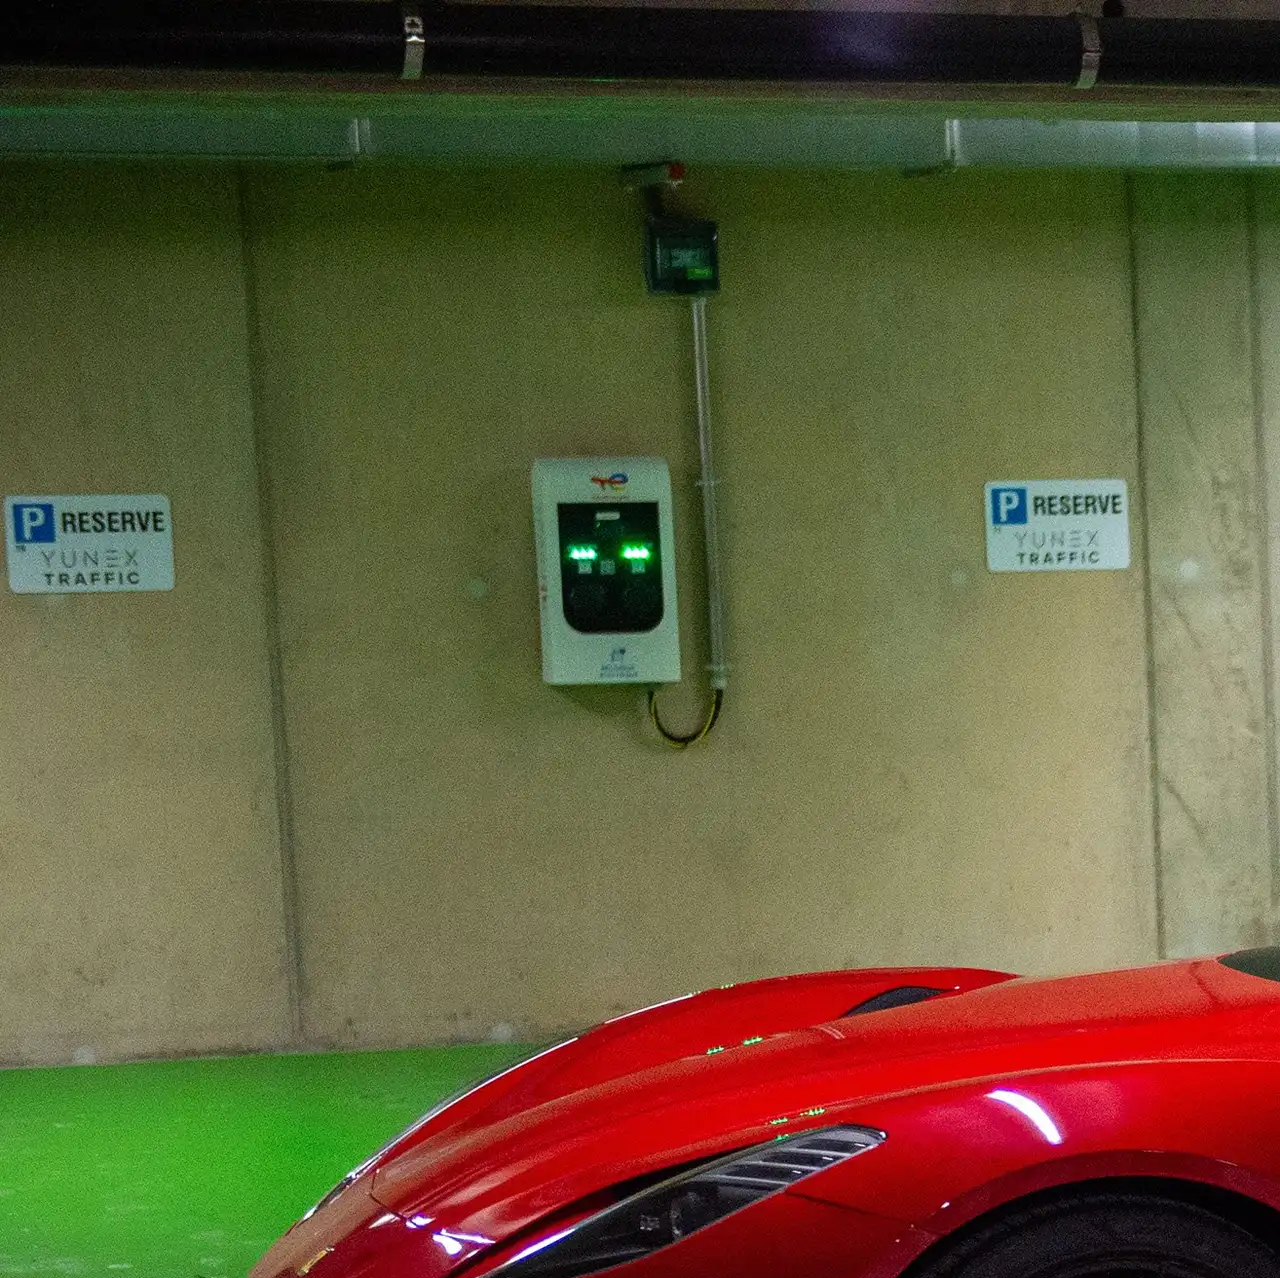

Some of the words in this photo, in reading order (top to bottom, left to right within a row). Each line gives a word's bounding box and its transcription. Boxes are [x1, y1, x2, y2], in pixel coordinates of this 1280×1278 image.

[999, 491, 1019, 522] P
[1033, 494, 1122, 516] RESERVE
[22, 507, 45, 540] P
[61, 511, 165, 533] RESERVE
[1014, 530, 1099, 548] YUNEX
[41, 549, 138, 568] YUNEX
[1017, 551, 1100, 566] TRAFFIC
[44, 572, 140, 586] TRAFFIC
